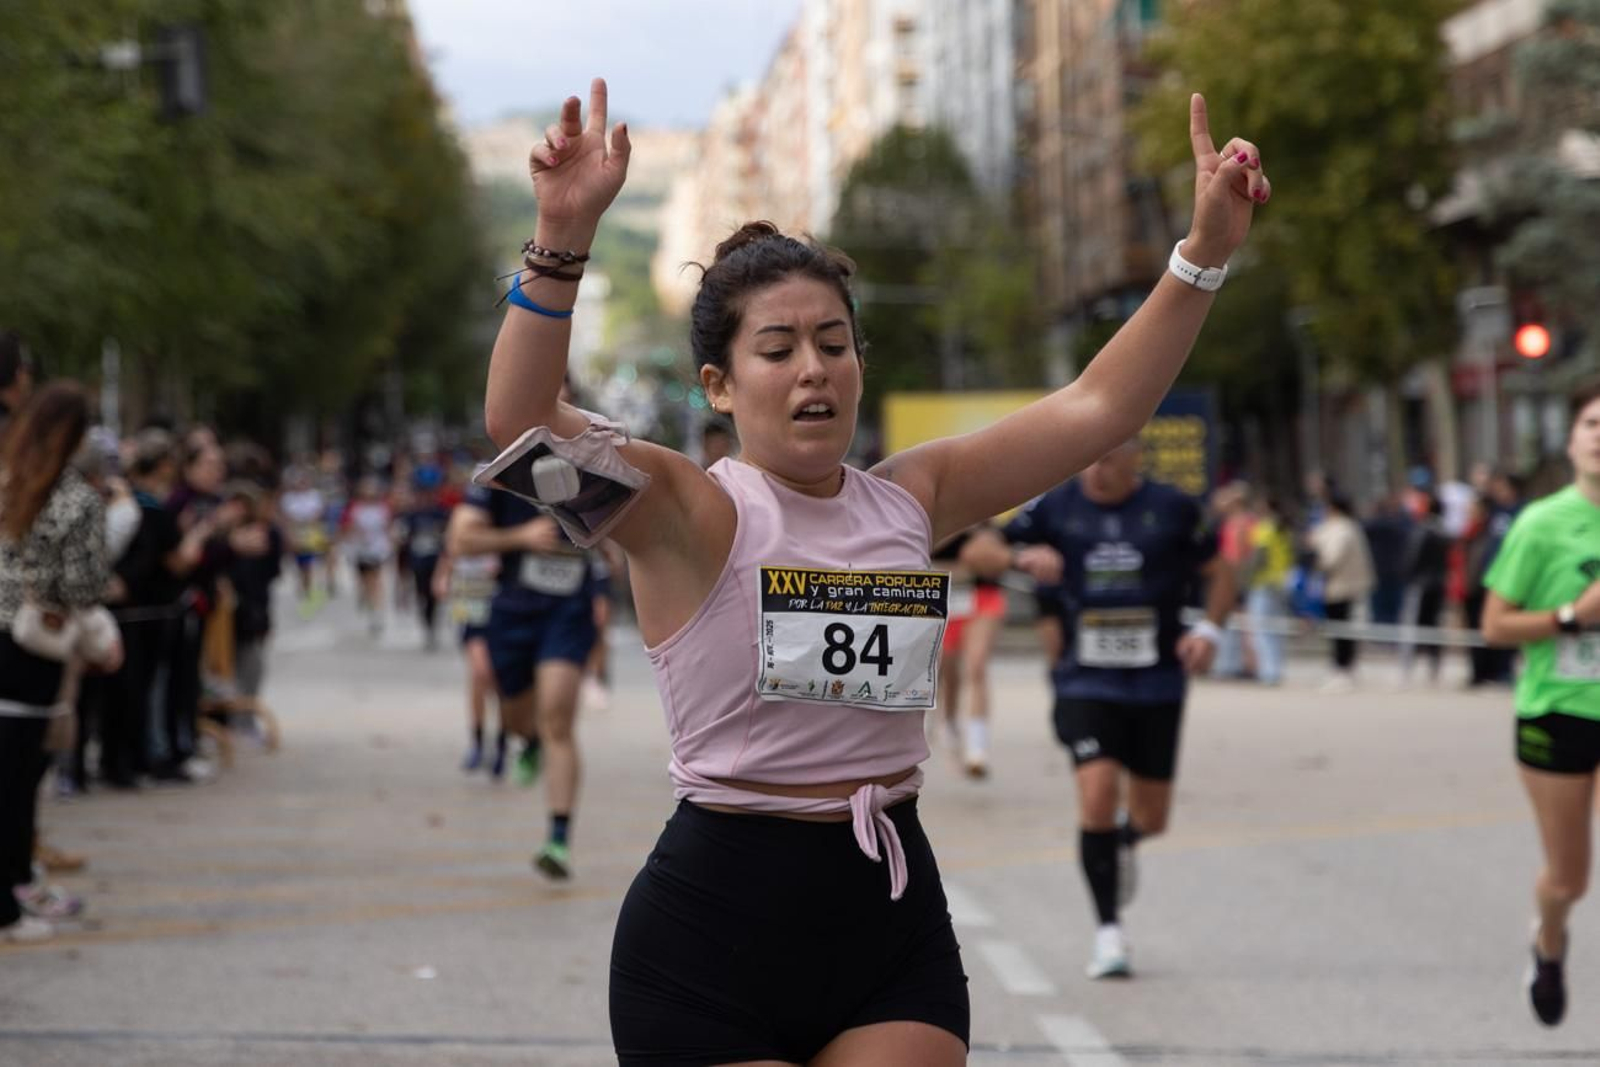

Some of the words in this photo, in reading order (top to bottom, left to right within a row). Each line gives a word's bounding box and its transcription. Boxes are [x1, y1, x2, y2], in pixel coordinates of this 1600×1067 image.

[767, 570, 806, 595] XXV
[809, 573, 872, 586] CARRERA
[875, 575, 941, 588] POPULAR
[810, 585, 819, 597] y
[828, 586, 864, 598] gran
[872, 587, 941, 599] caminata
[788, 598, 808, 609] POR
[810, 600, 824, 610] LA
[822, 622, 893, 677] 84
